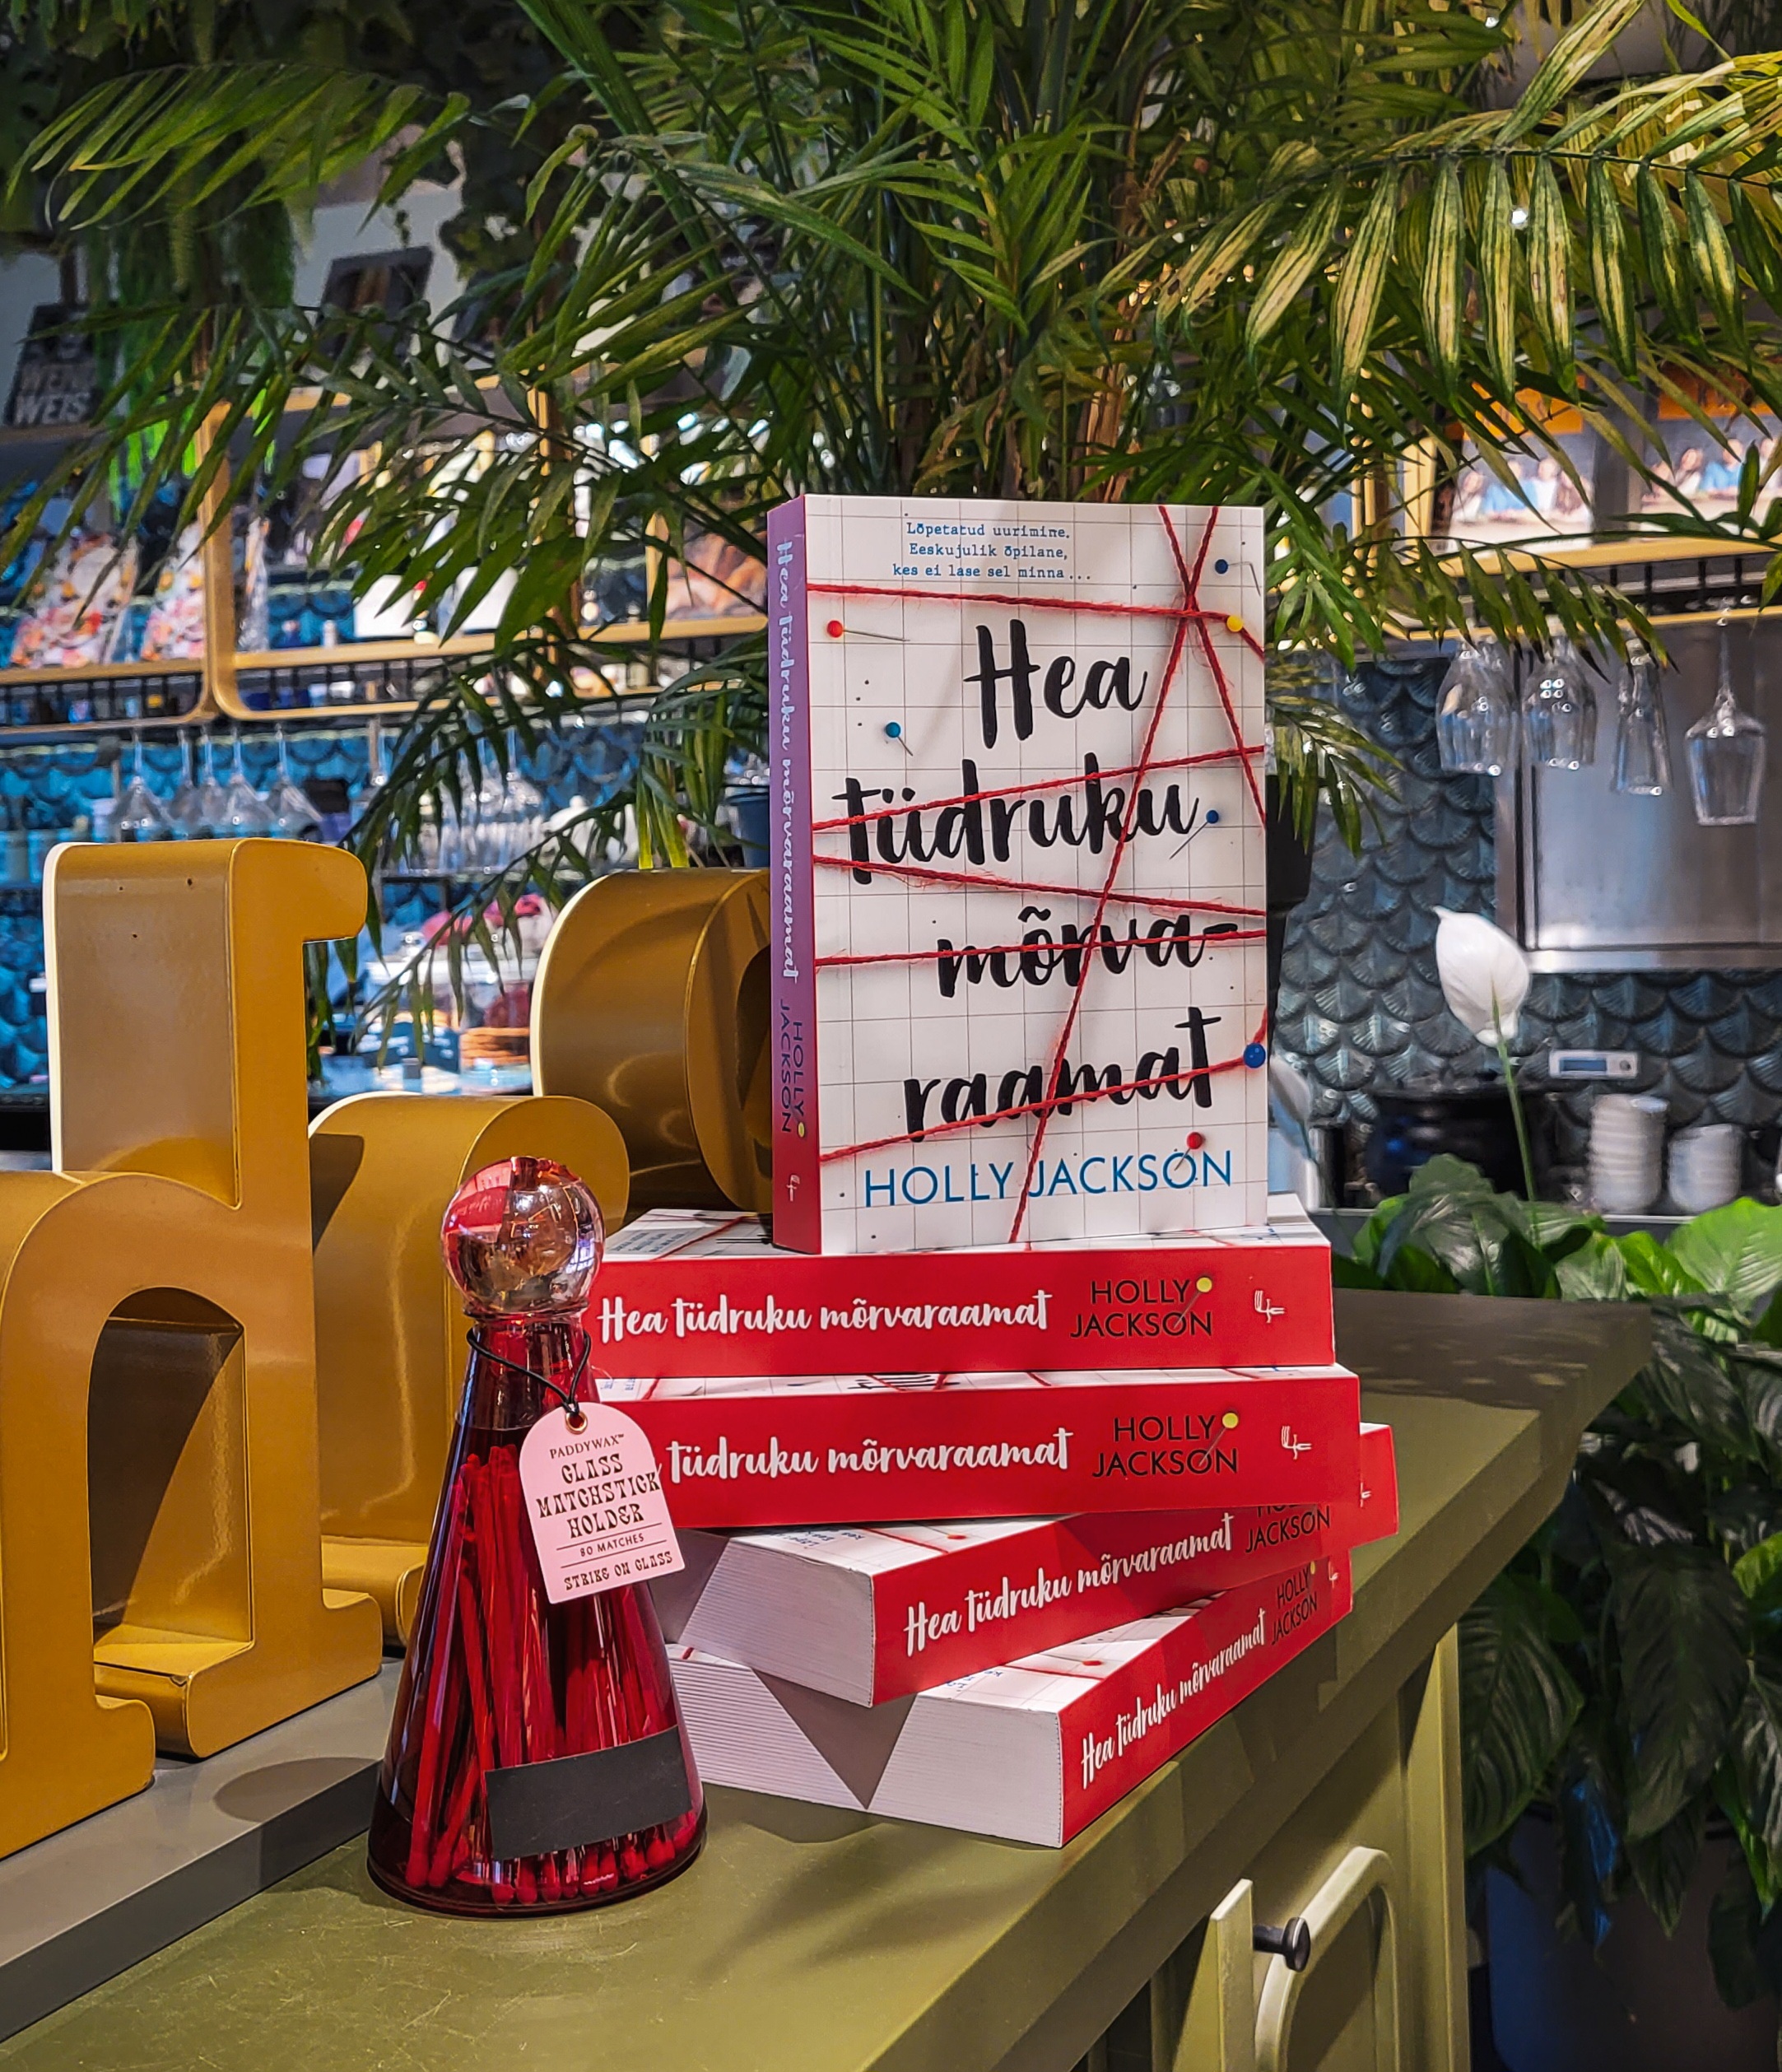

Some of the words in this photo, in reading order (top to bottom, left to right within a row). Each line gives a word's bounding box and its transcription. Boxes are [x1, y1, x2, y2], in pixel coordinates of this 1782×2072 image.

[906, 523, 985, 538] Lõpetatud
[993, 525, 1070, 538] uurimine.
[910, 543, 997, 559] Eeskujulik
[1004, 546, 1068, 561] õpilane,
[777, 538, 793, 608] Hea
[893, 564, 918, 576] kes
[925, 565, 942, 577] ei
[949, 565, 980, 577] lase
[988, 566, 1011, 578] sel
[779, 612, 795, 751] tüdruku
[964, 619, 1147, 748] Hea
[832, 752, 1199, 884] tüdruku
[782, 758, 799, 984] mõrvaraamat
[937, 906, 1238, 998] mõrva-
[780, 999, 792, 1133] JACKSON
[793, 1021, 805, 1118] HOLLY
[904, 1007, 1221, 1143] raamat
[864, 1162, 1013, 1208] HOLLY
[1027, 1150, 1232, 1198] JACKSON
[598, 1297, 668, 1343] Hea
[672, 1294, 812, 1337] tüdruku
[821, 1289, 1053, 1330] mõrvaraamat
[1091, 1279, 1190, 1304] HOLLY
[1070, 1311, 1212, 1339] JACKSON
[666, 1436, 819, 1483] tüdruku
[828, 1427, 1073, 1474] mõrvaraamat
[1114, 1415, 1216, 1442] HOLLY
[561, 1453, 623, 1484] GLASS
[1091, 1448, 1237, 1478] JACKSON
[536, 1471, 660, 1518] MATCHSTICK
[567, 1503, 644, 1539] HOLDER
[580, 1547, 593, 1557] 80
[597, 1533, 644, 1553] MATCHES
[1245, 1505, 1331, 1553] JACKSON
[564, 1567, 610, 1590] STRIKE
[614, 1561, 631, 1577] ON
[635, 1551, 673, 1571] GLASS
[903, 1601, 962, 1657] Hea
[964, 1567, 1072, 1632] tüdruku
[1077, 1512, 1234, 1596] mõrvaraamat
[1277, 1567, 1310, 1609] HOLLY
[1272, 1591, 1317, 1646] JACKSON
[1081, 1732, 1115, 1790] Hea
[1116, 1684, 1177, 1758] tüdruku
[1178, 1608, 1266, 1704] mõrvaraamat
